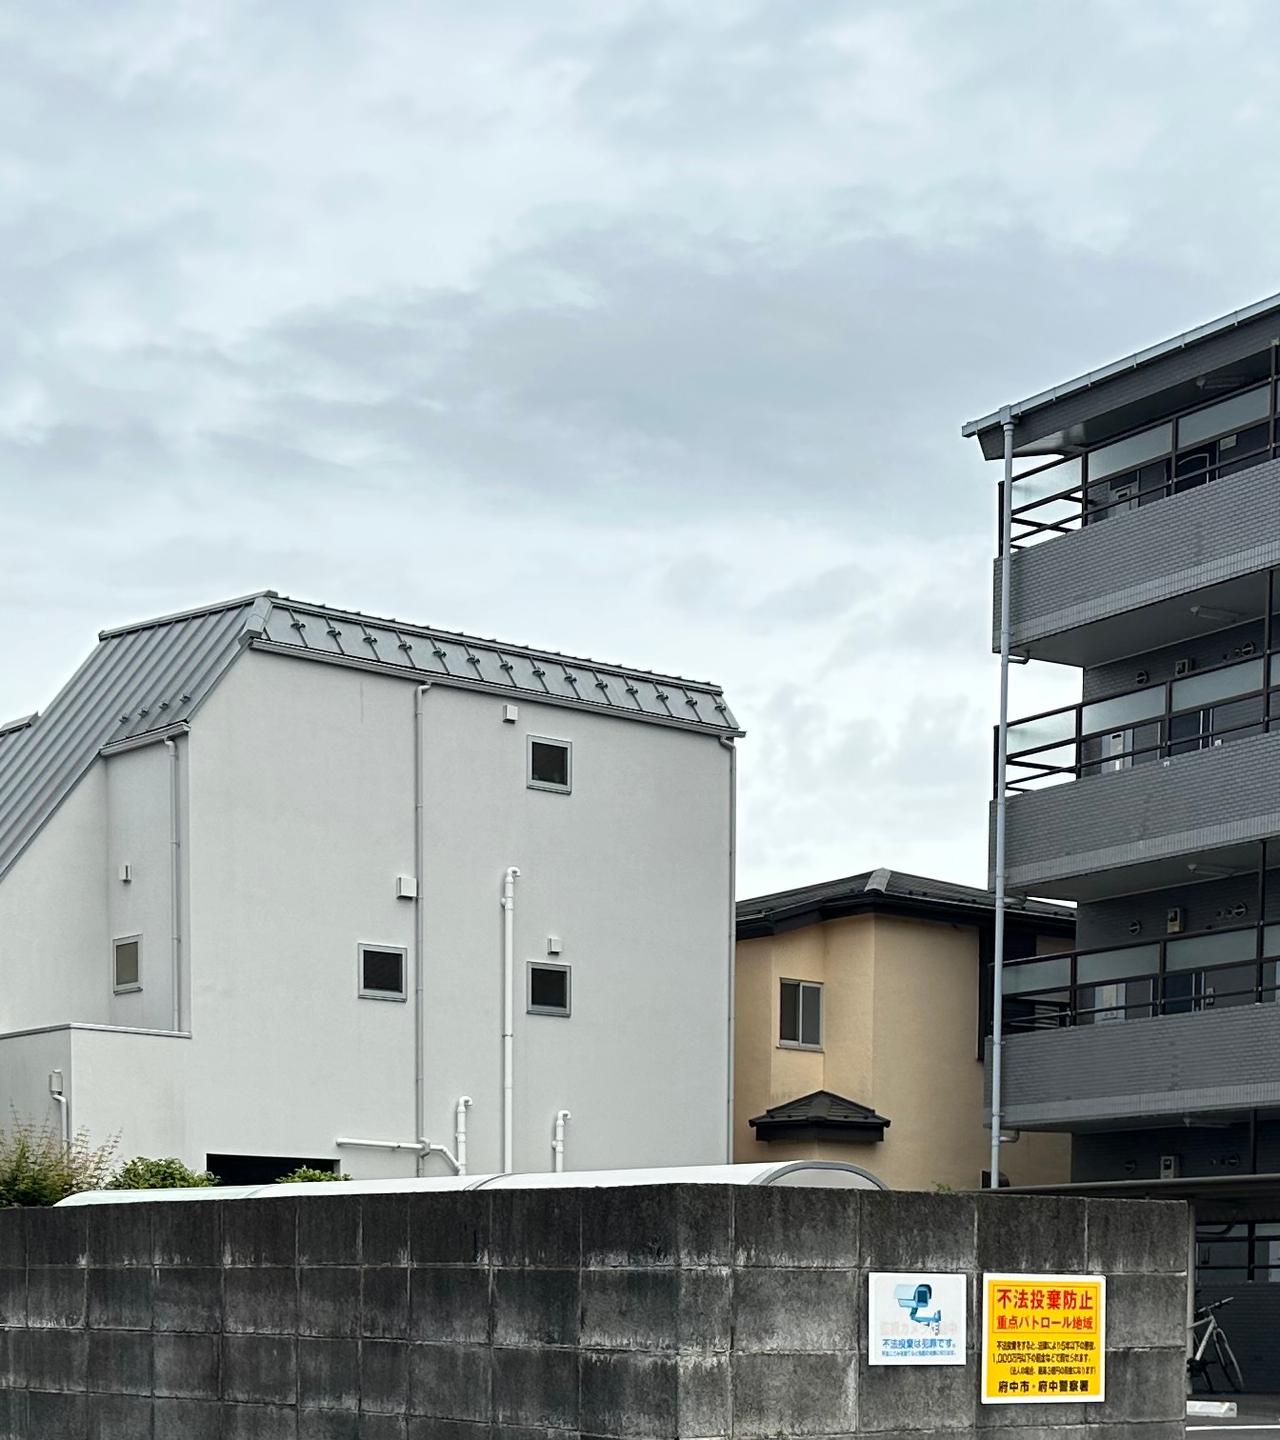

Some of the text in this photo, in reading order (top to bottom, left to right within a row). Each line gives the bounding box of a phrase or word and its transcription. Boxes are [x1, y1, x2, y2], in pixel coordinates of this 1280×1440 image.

[997, 1288, 1093, 1310] 不法投棄防止
[997, 1314, 1093, 1330] 重点パトロール地域
[998, 1380, 1089, 1393] 府中市・府中警察署
